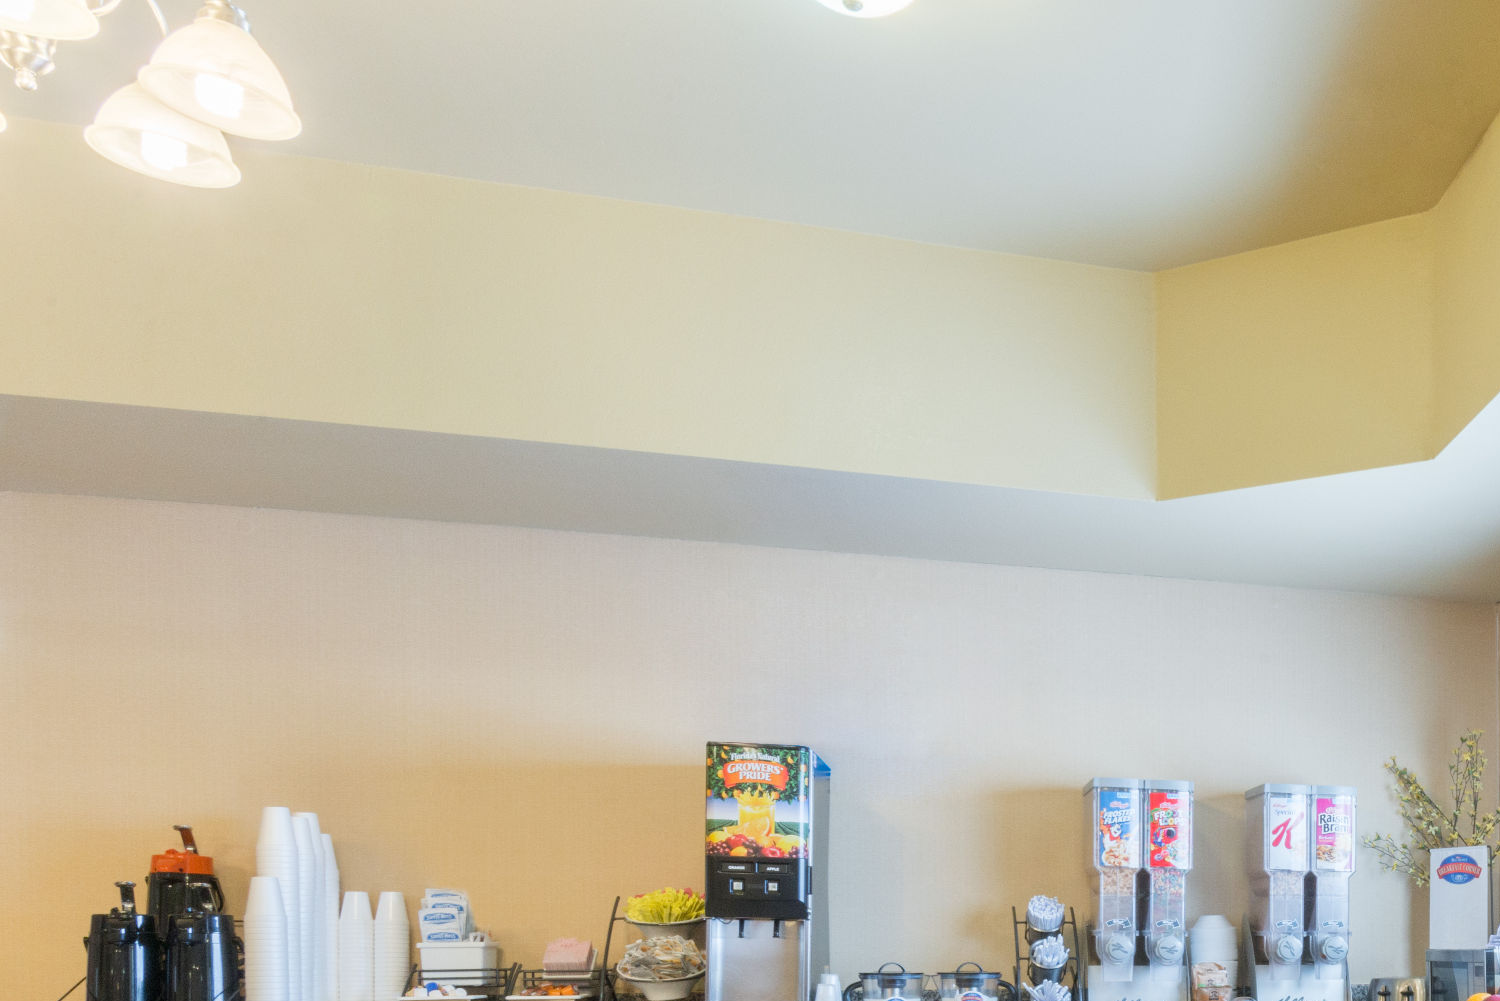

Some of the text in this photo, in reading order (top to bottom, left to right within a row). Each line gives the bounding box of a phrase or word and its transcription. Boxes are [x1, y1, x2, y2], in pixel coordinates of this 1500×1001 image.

[739, 770, 771, 781] PRIDE
[1319, 813, 1349, 825] Raisin
[1323, 823, 1348, 833] Bran
